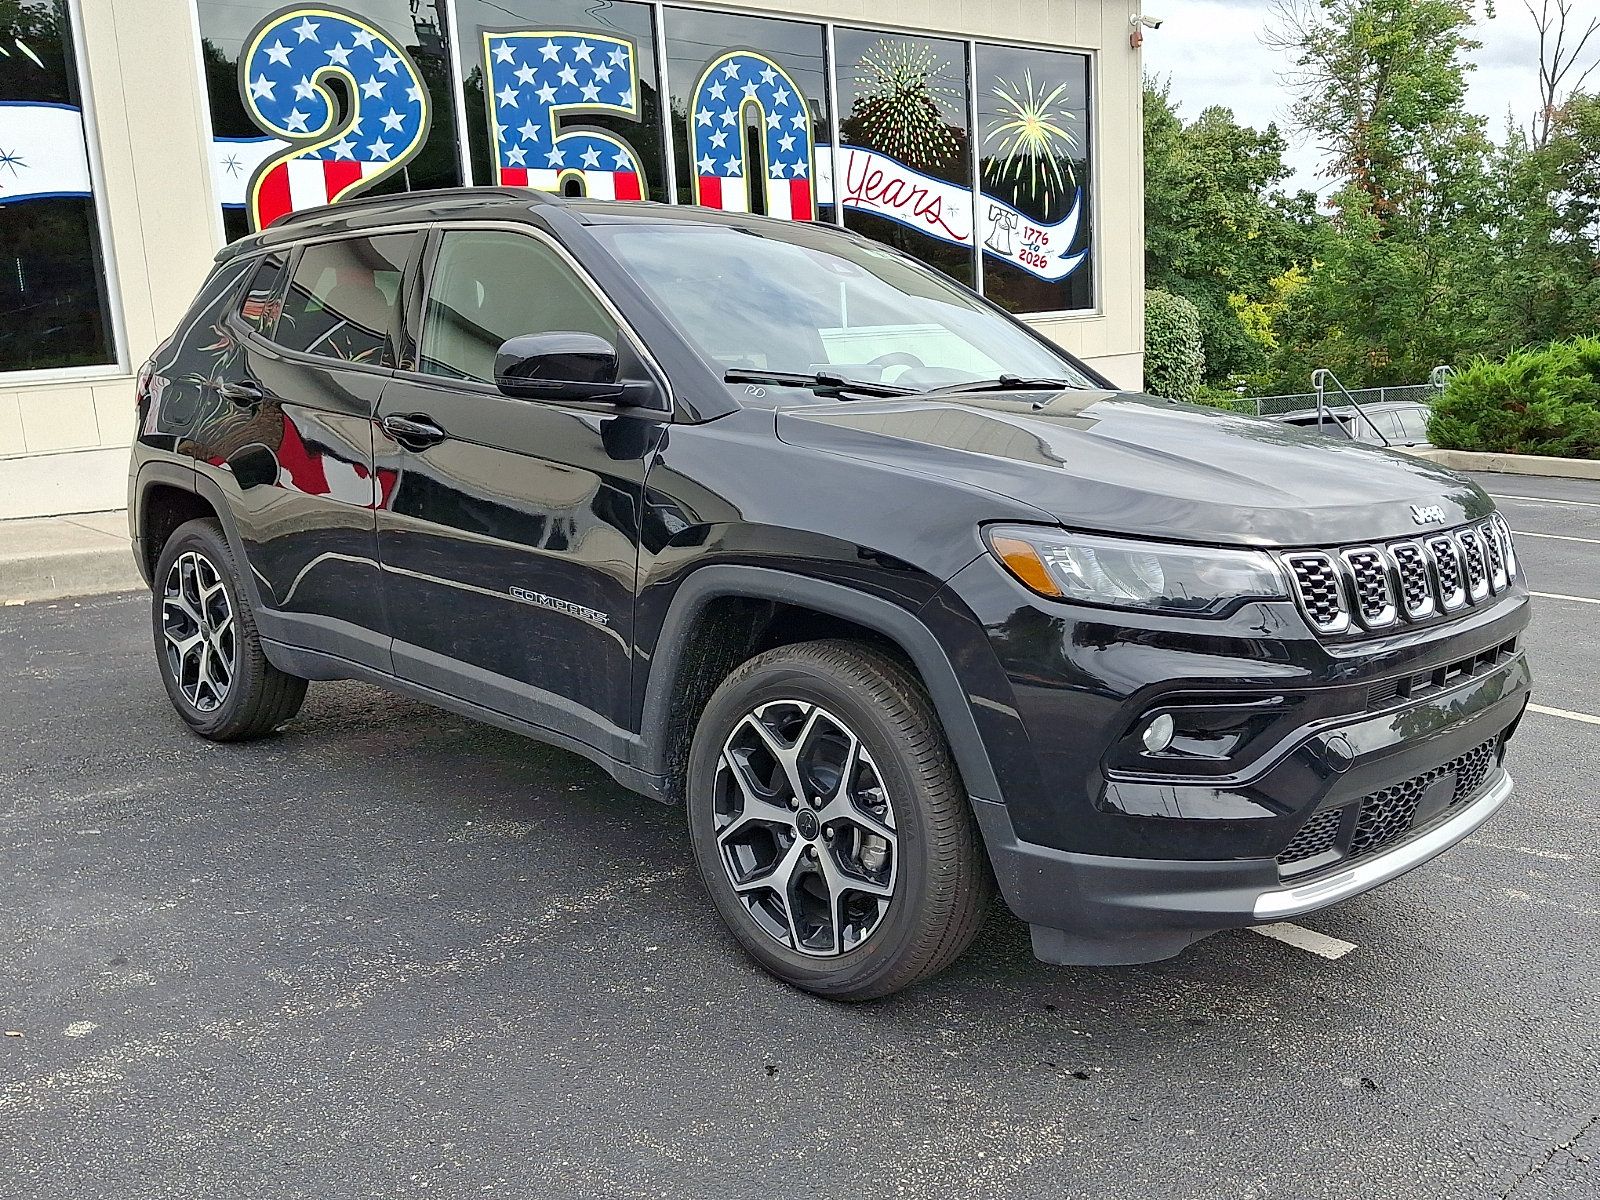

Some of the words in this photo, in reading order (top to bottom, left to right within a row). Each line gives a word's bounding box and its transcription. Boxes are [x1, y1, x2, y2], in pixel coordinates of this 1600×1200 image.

[240, 4, 815, 230] 250
[843, 151, 969, 240] Years
[1024, 226, 1048, 245] 1776
[1020, 241, 1040, 252] to
[1019, 249, 1047, 268] 2026
[1409, 504, 1446, 525] Jeep
[508, 585, 610, 625] COMPASS
